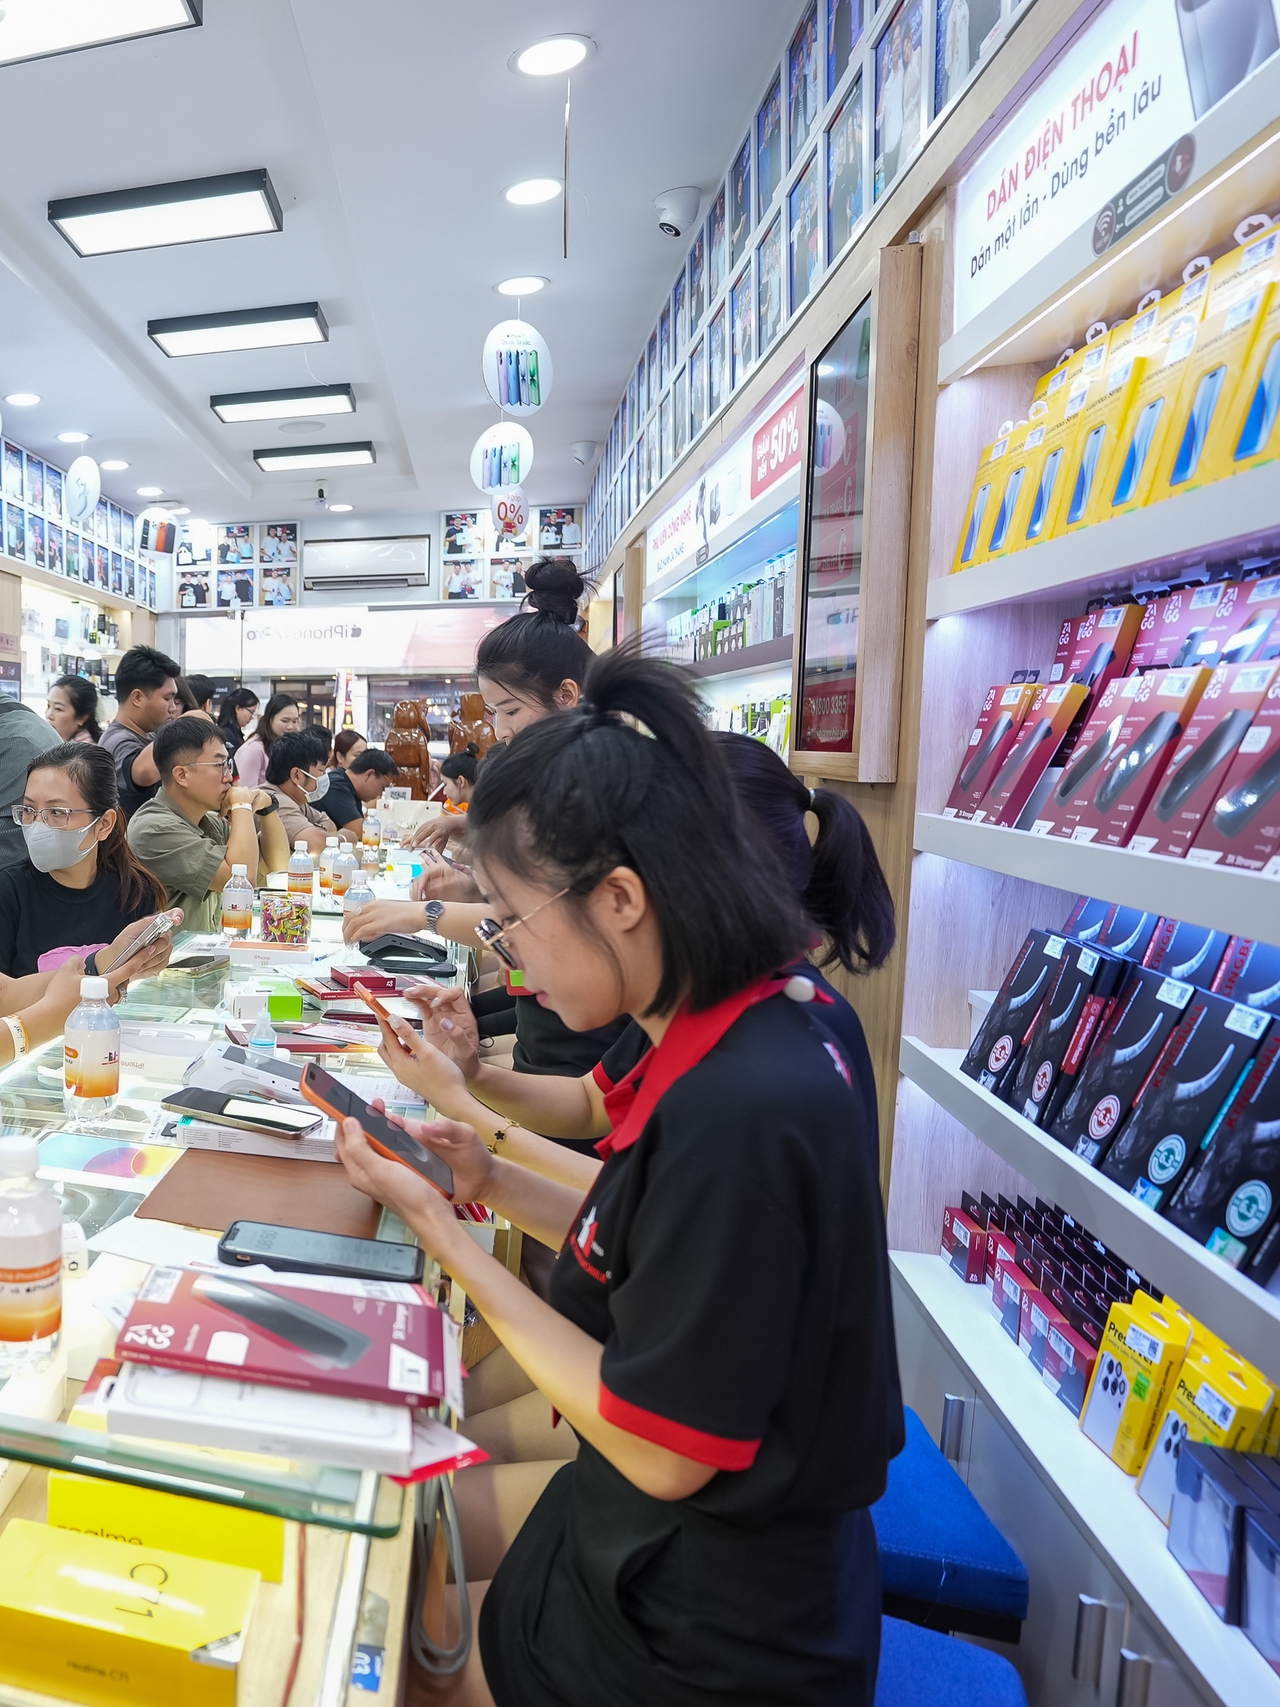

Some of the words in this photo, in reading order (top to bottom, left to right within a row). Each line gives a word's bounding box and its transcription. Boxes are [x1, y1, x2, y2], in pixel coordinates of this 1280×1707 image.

[987, 161, 1019, 221] DÁN
[1024, 112, 1064, 181] ĐIỆN
[1071, 30, 1138, 131] THOẠI
[971, 242, 991, 279] Dán
[994, 215, 1016, 257] một
[1020, 192, 1038, 230] lần
[1051, 147, 1089, 199] Dùng
[1095, 107, 1126, 158] bền
[1132, 74, 1162, 121] lâu
[770, 406, 799, 470] 50%
[497, 501, 523, 525] 0%
[830, 695, 847, 713] 3355
[121, 1060, 145, 1070] iPhone
[1152, 1004, 1206, 1089] KINGBULL
[67, 1659, 106, 1679] realme
